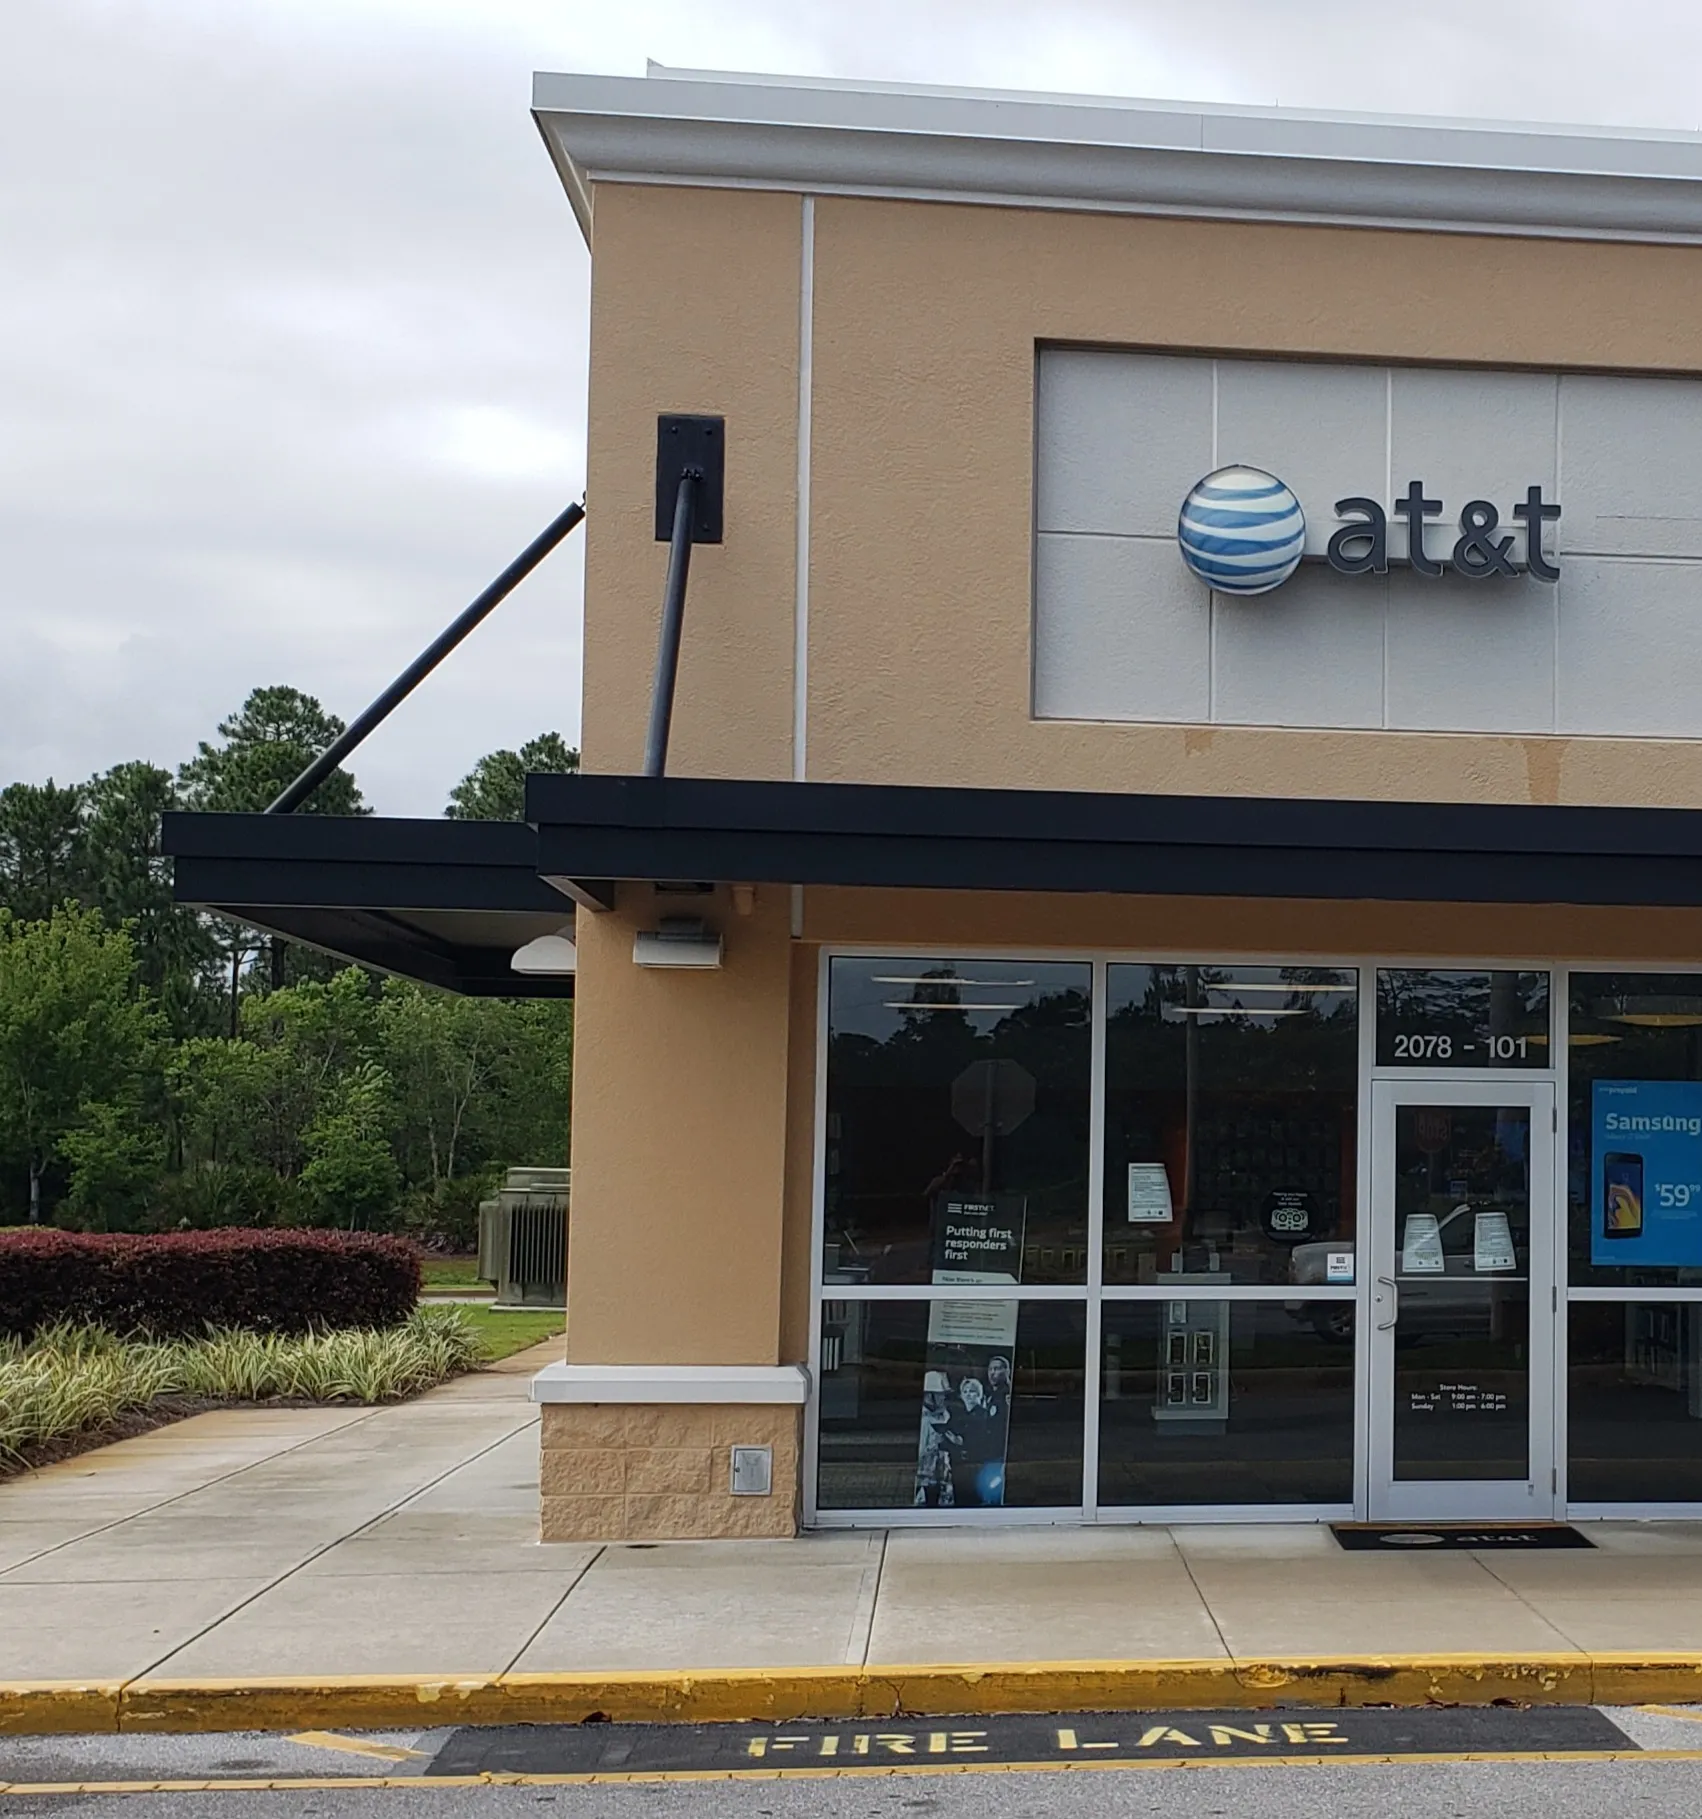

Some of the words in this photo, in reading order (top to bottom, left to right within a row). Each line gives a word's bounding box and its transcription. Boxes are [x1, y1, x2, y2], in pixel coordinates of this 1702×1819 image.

[1327, 480, 1562, 583] at&t
[1394, 1034, 1452, 1058] 2078
[1486, 1035, 1526, 1058] 101
[1605, 1113, 1701, 1137] Samsung
[945, 1225, 988, 1240] Putting
[988, 1227, 1013, 1239] first
[944, 1239, 1008, 1251] responders
[944, 1248, 969, 1260] first
[1411, 1403, 1434, 1411] Sunday
[747, 1732, 989, 1757] FIRE
[1057, 1722, 1349, 1750] LANE
